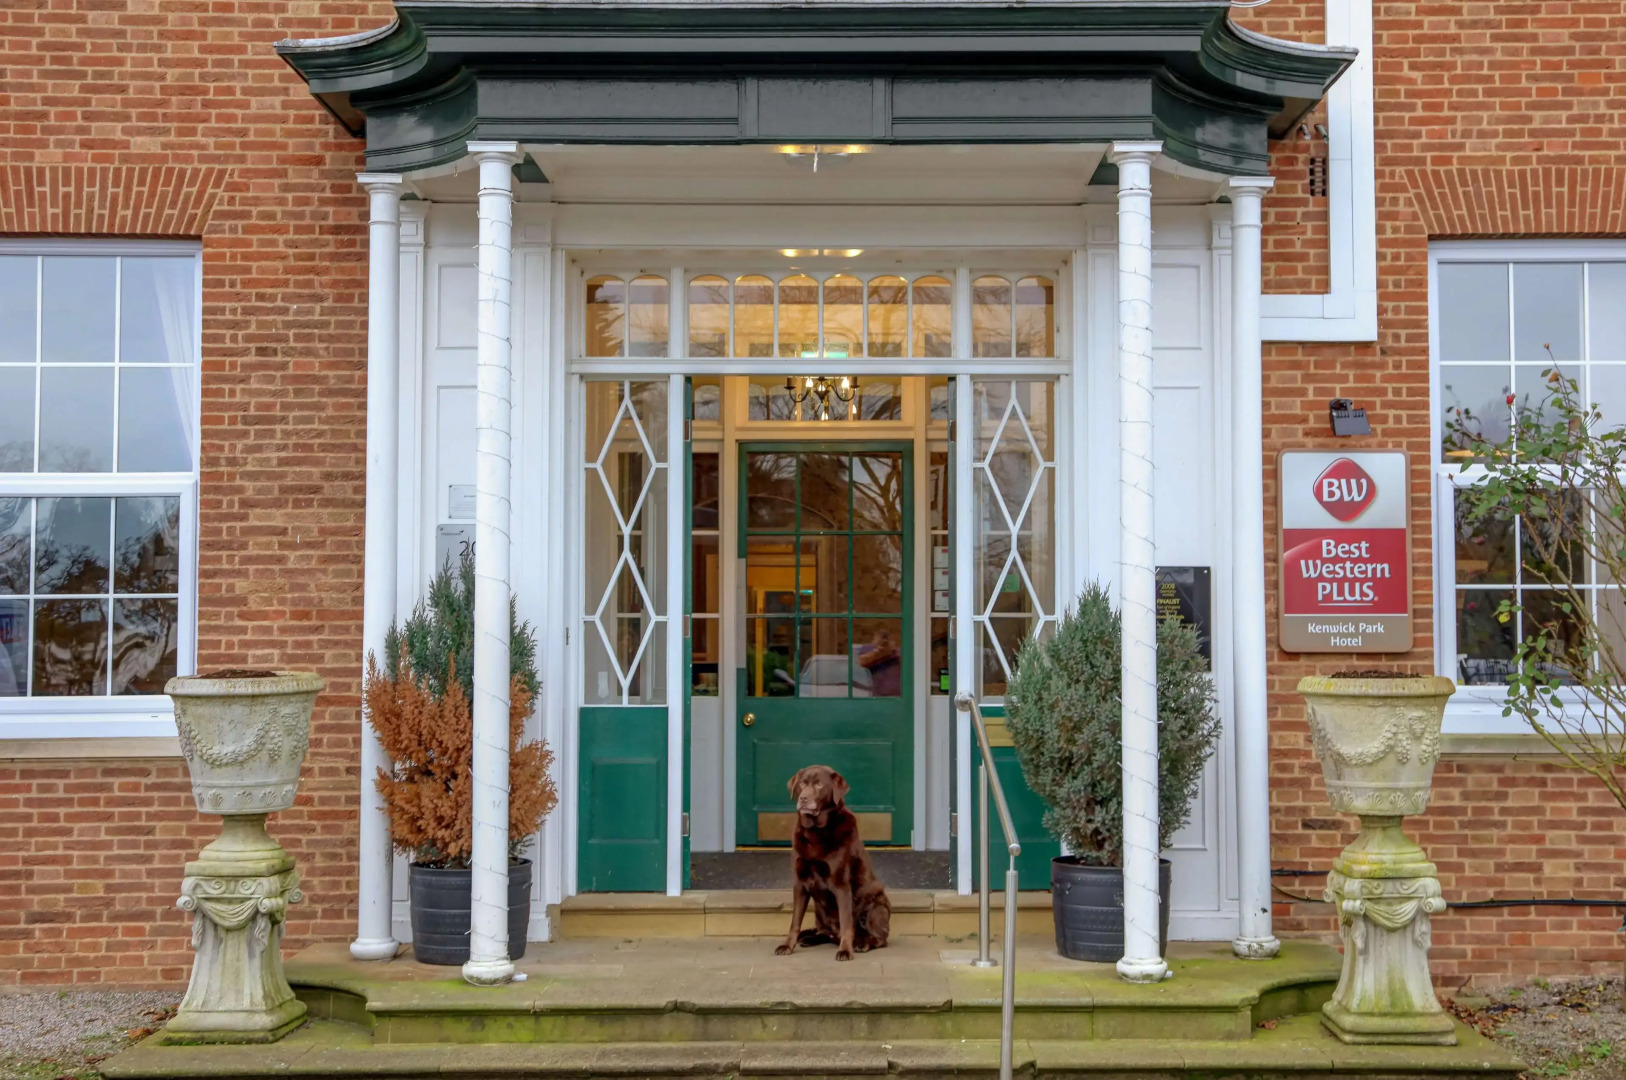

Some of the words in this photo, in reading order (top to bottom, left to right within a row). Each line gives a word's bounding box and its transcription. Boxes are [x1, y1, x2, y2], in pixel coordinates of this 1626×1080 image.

[1322, 478, 1368, 502] BW
[1321, 539, 1370, 559] Best
[1300, 559, 1391, 579] Western
[1317, 582, 1374, 602] PLUS
[1308, 622, 1355, 634] Kenwick
[1359, 622, 1385, 634] Park
[1330, 635, 1363, 647] Hotel
